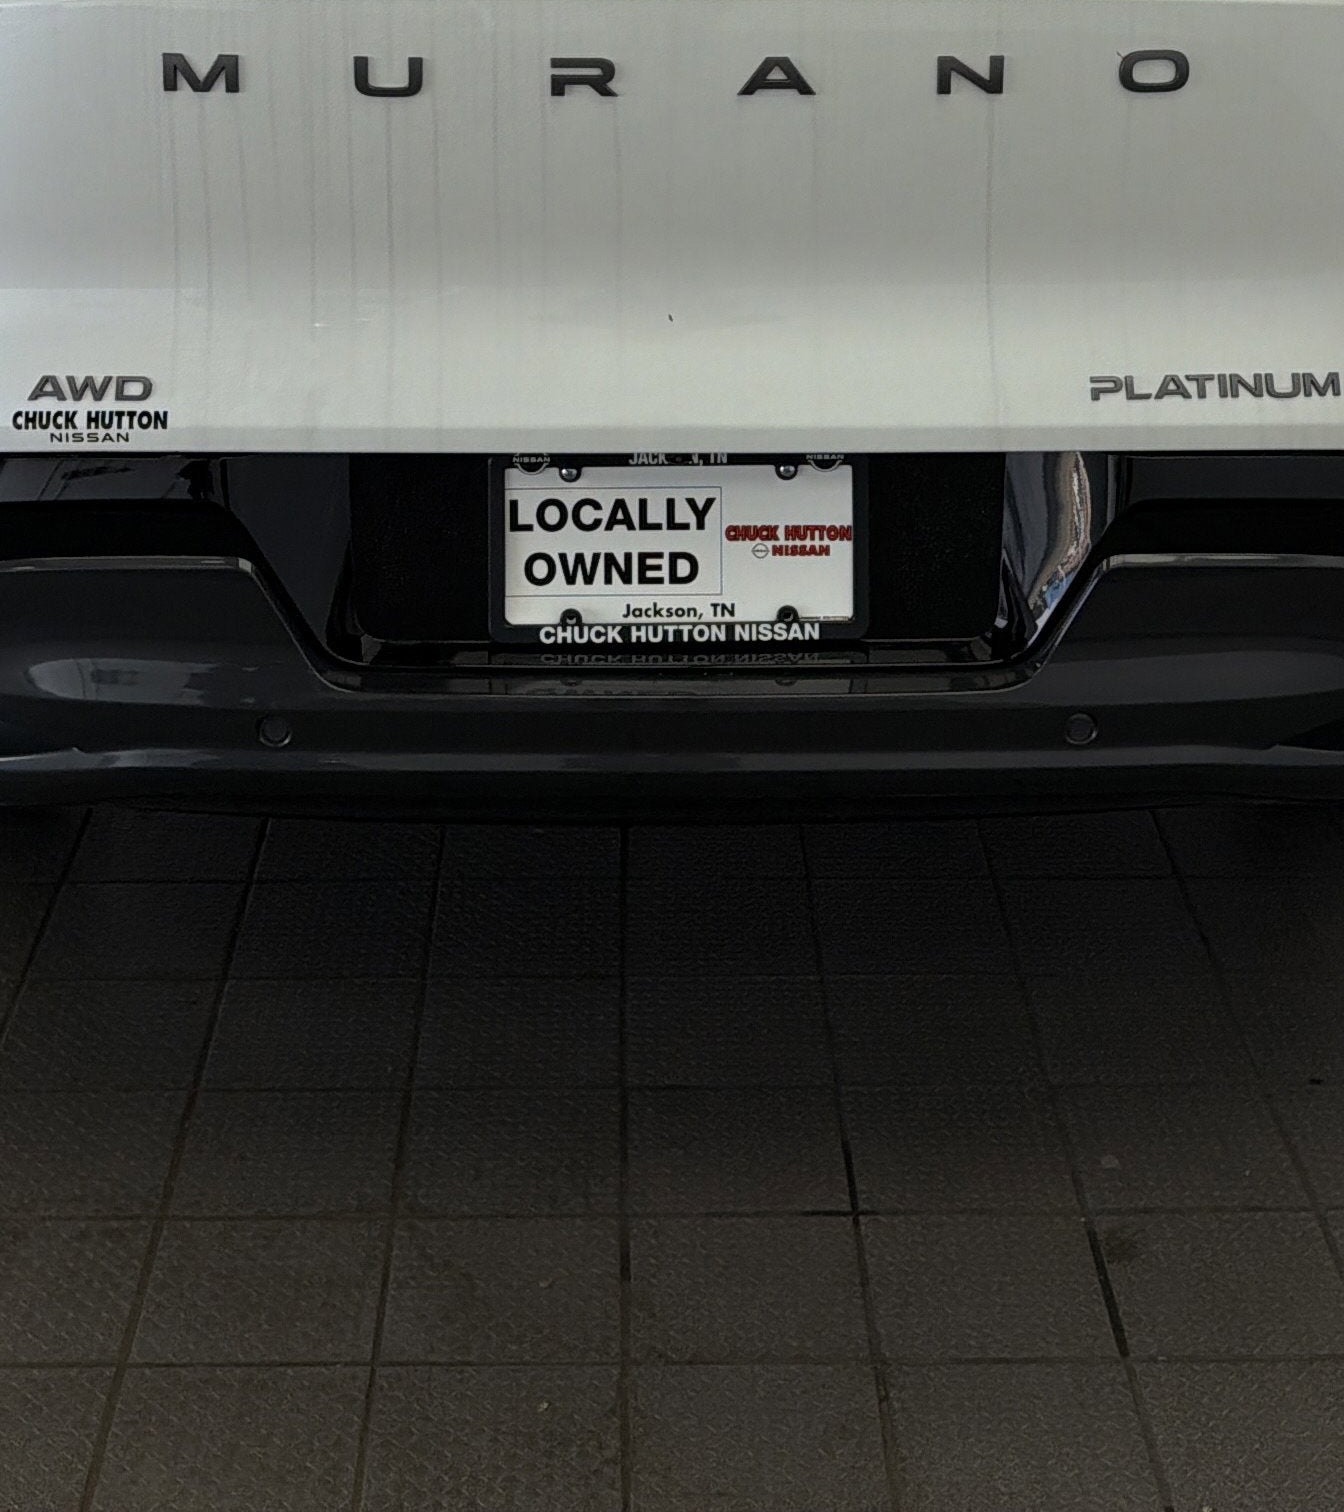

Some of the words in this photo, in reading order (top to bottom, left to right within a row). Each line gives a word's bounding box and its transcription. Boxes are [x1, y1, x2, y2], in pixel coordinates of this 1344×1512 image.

[162, 49, 1190, 98] MURANO
[27, 375, 153, 402] AWD
[1089, 371, 1341, 401] PLATINUM
[12, 410, 78, 430] CHUCK
[86, 410, 169, 430] HUTTON
[50, 432, 130, 443] NISSAN
[628, 452, 704, 466] JACKN,
[509, 497, 716, 532] LOCALLY
[725, 524, 780, 541] CHUCK
[784, 524, 853, 541] HUTTON
[772, 545, 830, 556] NISSAN
[524, 551, 699, 586] OWNED
[622, 602, 703, 620] Jackson,
[710, 603, 735, 618] TN
[539, 625, 623, 644] CHUCK
[631, 624, 726, 643] HUTTON
[735, 623, 820, 641] NISSAN
